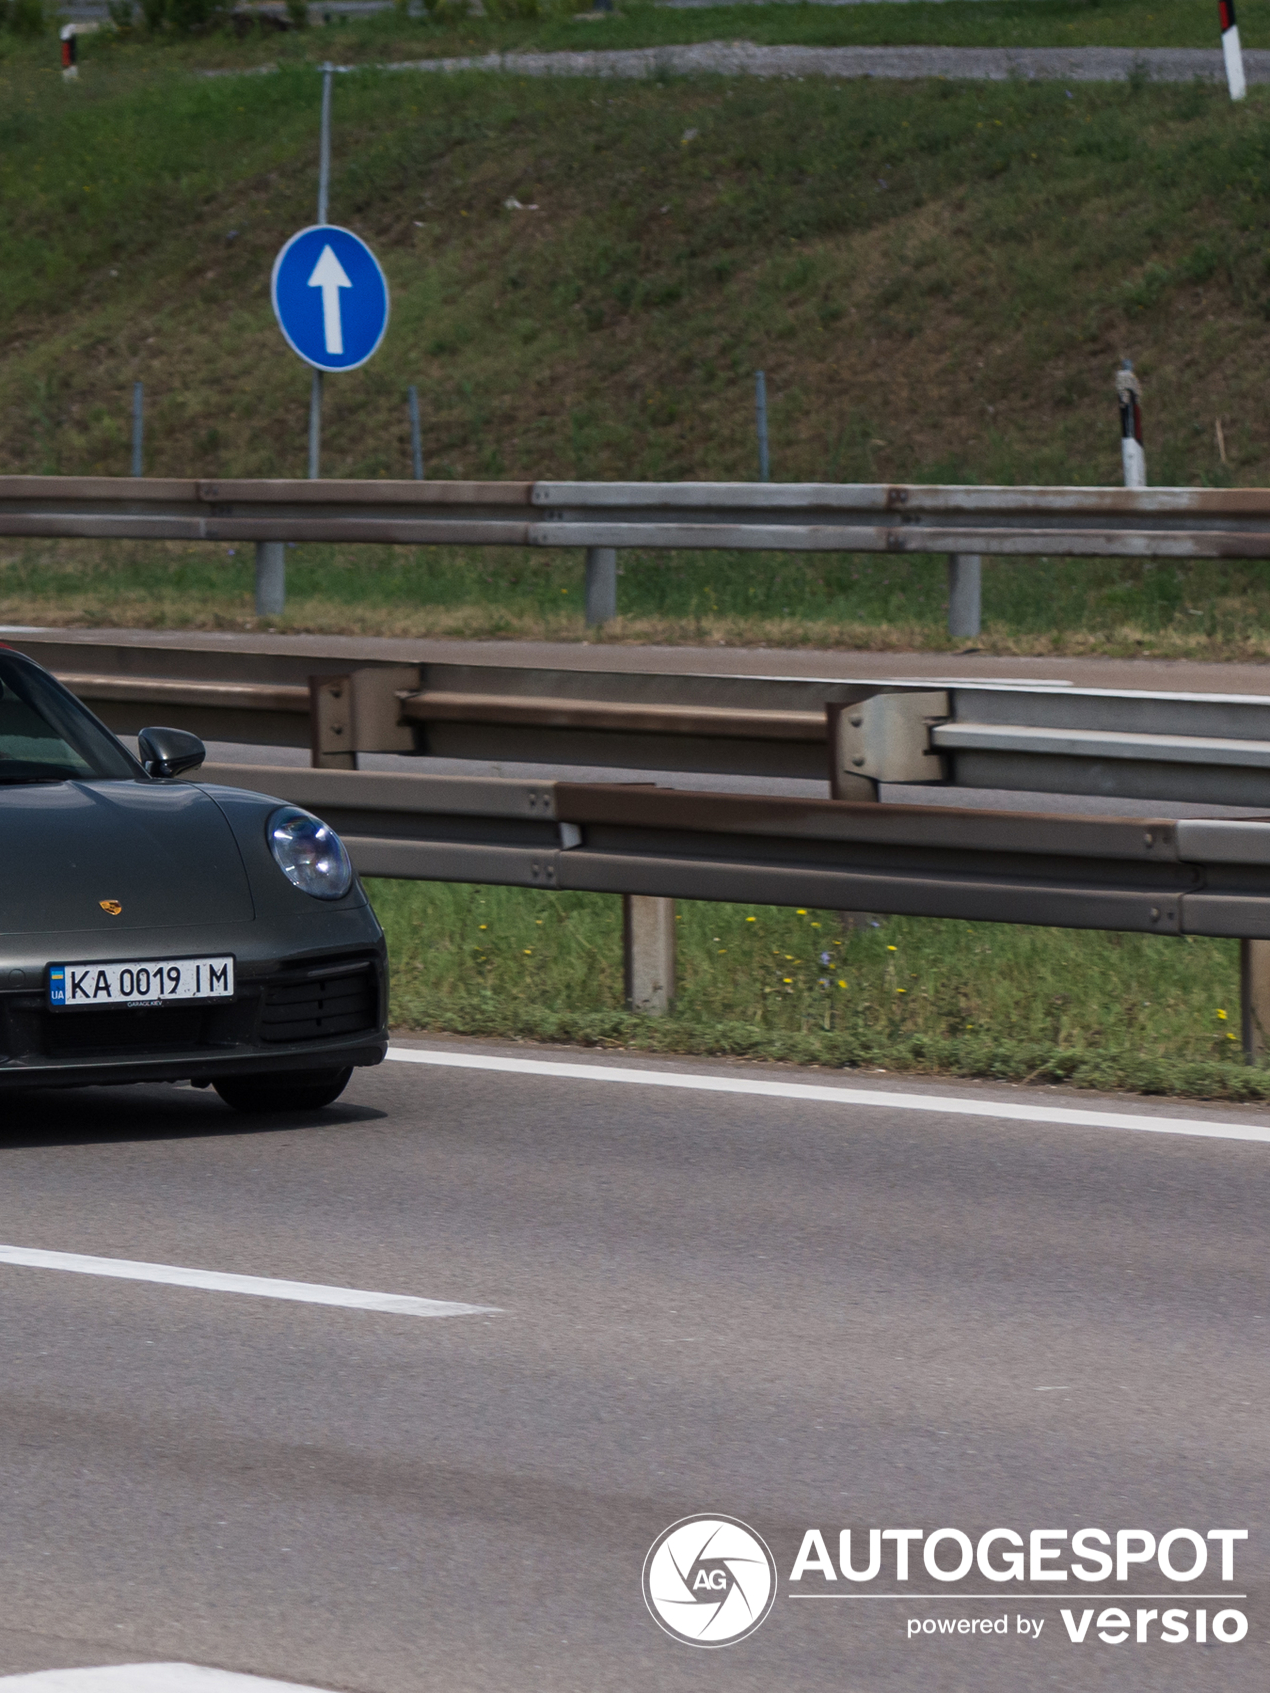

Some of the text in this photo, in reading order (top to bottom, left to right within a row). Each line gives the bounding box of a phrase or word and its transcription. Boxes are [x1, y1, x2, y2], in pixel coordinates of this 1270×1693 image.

[71, 963, 228, 999] KA 0019 IM
[51, 990, 65, 999] UA
